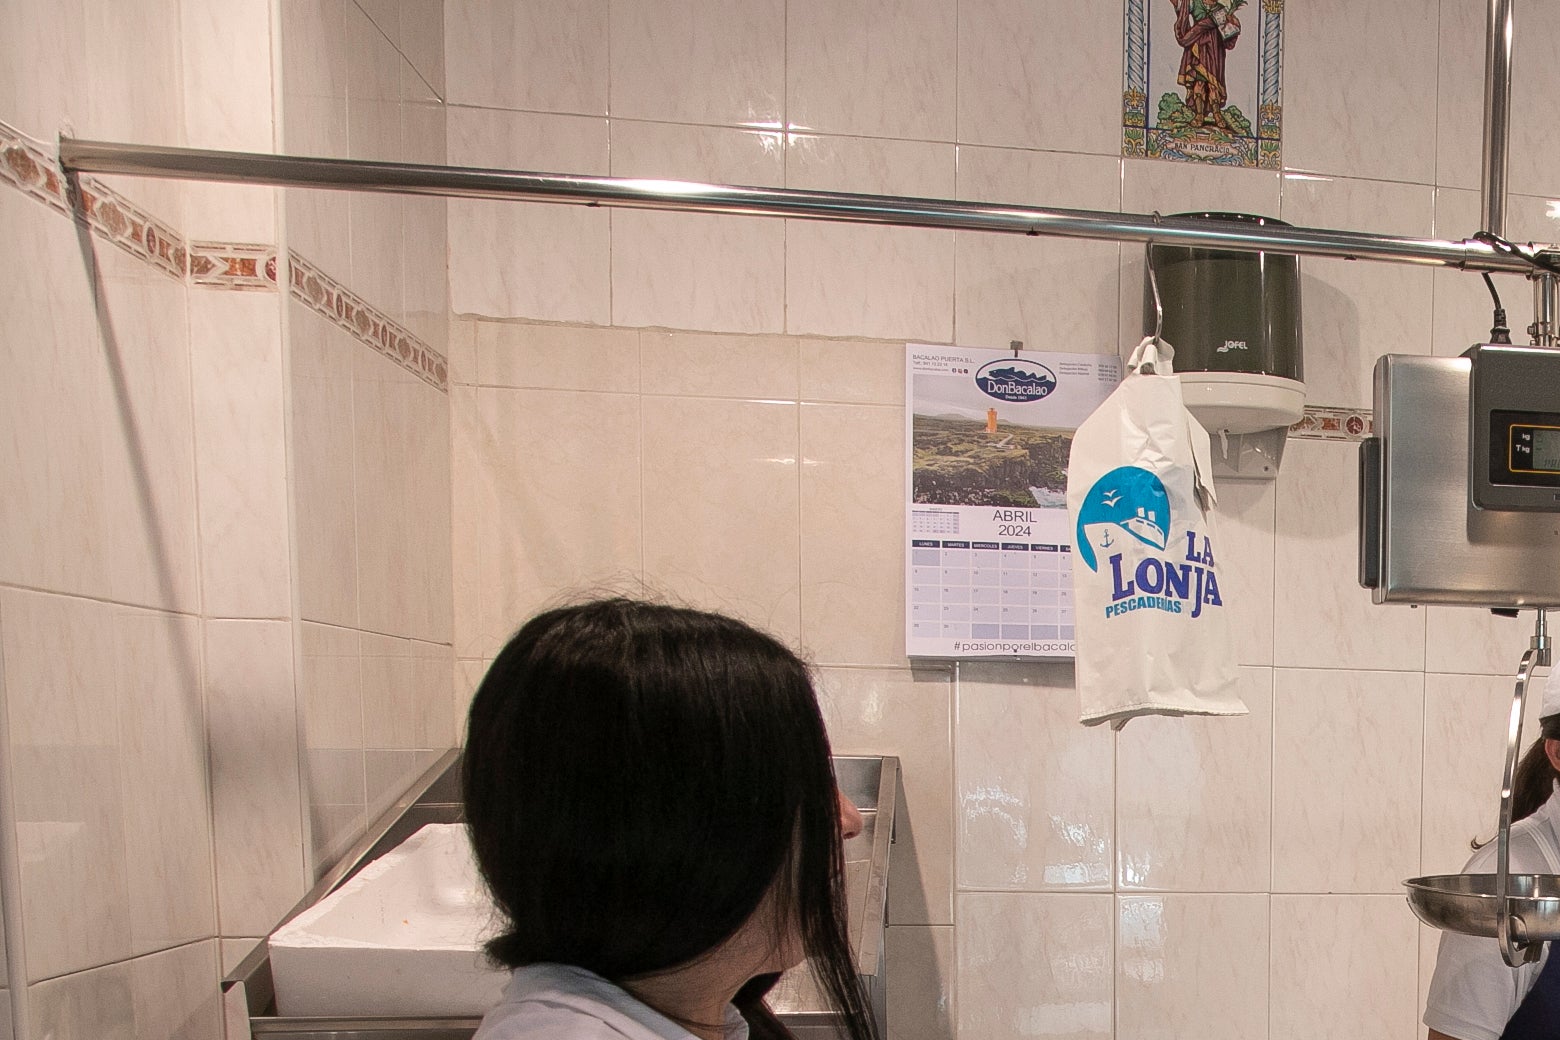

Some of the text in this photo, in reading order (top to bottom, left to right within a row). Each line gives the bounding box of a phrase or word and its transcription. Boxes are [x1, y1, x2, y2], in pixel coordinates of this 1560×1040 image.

[1219, 340, 1248, 351] JOFEL
[912, 354, 940, 362] BACALAO
[987, 381, 1048, 396] DonBacalao
[1522, 433, 1531, 441] kg
[1522, 446, 1531, 454] kg
[993, 510, 1038, 523] ABRIL
[998, 525, 1032, 537] 2024
[1186, 530, 1215, 568] LA
[1110, 553, 1223, 618] LONJA
